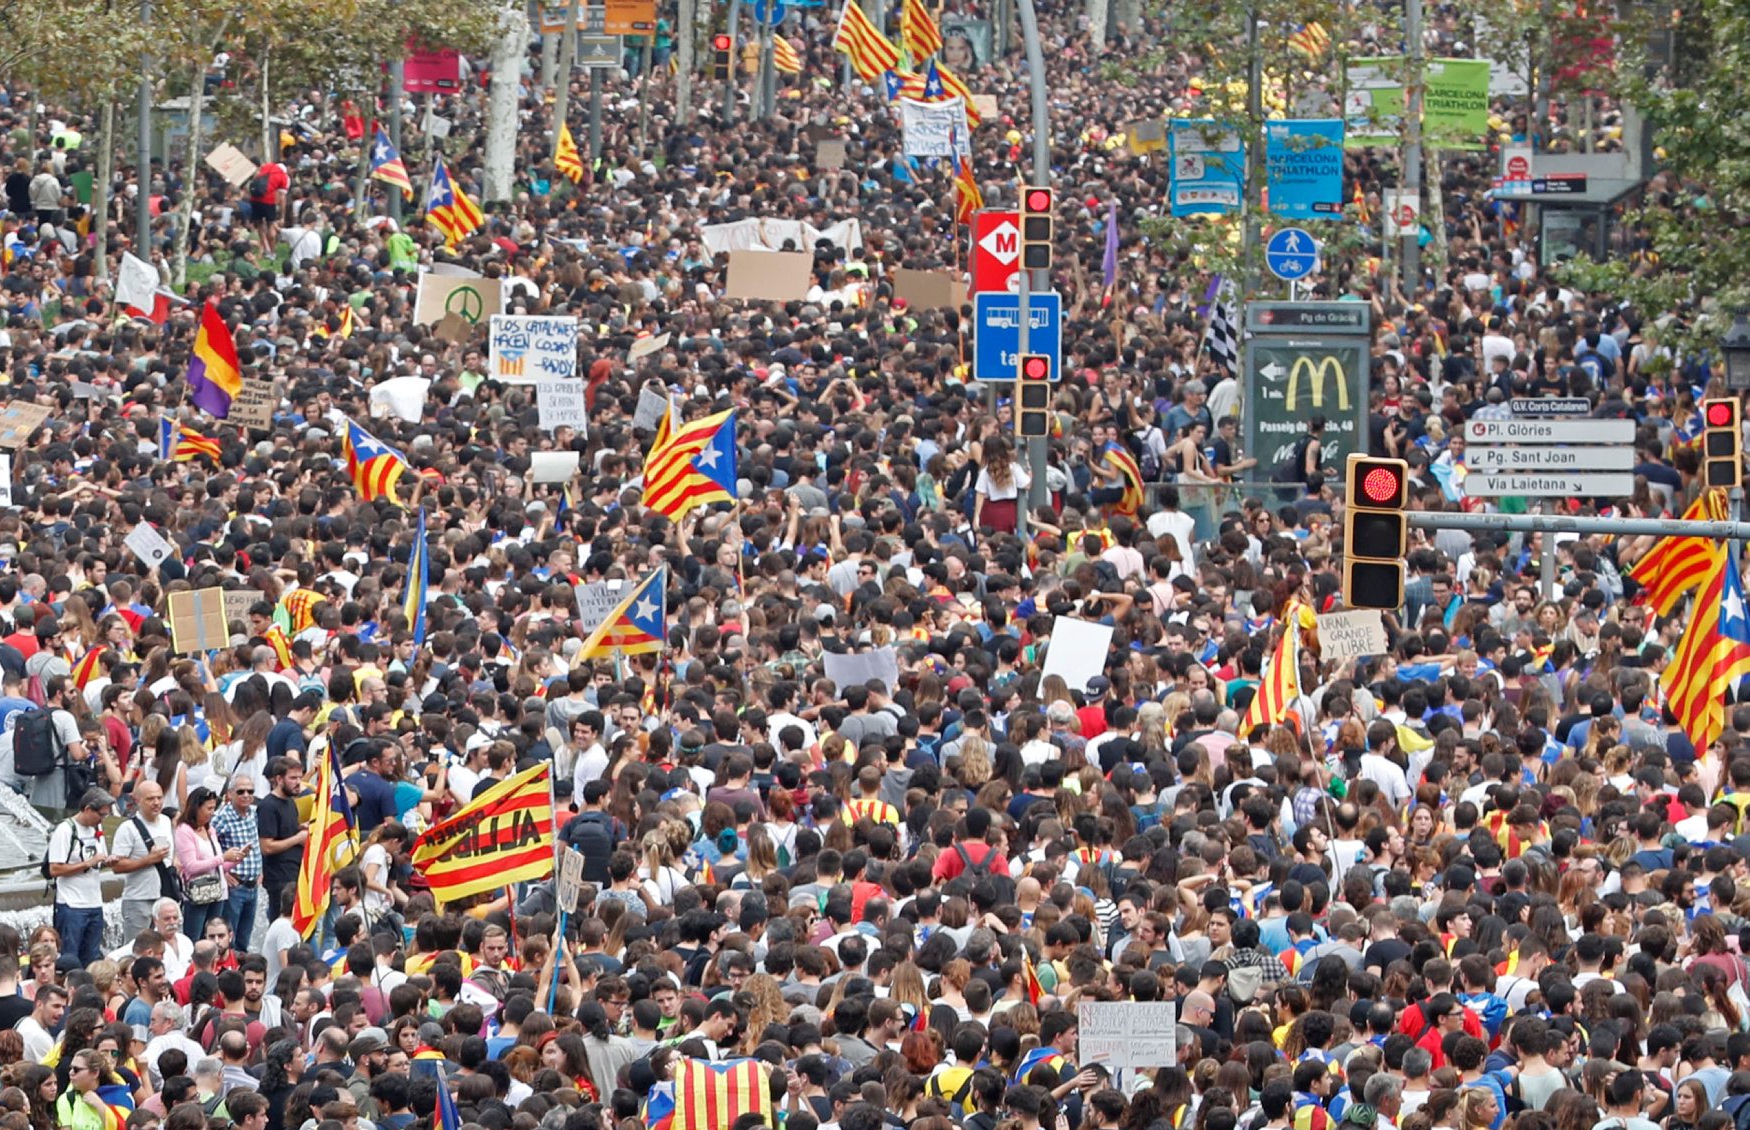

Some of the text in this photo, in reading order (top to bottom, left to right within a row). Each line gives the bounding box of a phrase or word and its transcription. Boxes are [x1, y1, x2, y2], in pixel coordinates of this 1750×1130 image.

[1427, 89, 1485, 99] BARCELONA
[1427, 99, 1486, 110] TRIATHLON
[1271, 153, 1338, 164] BARCELONA
[1272, 165, 1339, 176] TRIATHLON
[996, 233, 1016, 253] M
[1301, 313, 1313, 323] Pg
[1315, 314, 1326, 322] de
[493, 333, 530, 348] HACEN
[1262, 386, 1267, 399] 1
[1528, 401, 1549, 412] Corts
[1550, 401, 1588, 412] Catalanes
[1260, 421, 1296, 434] Passeig
[1296, 420, 1308, 432] de
[1488, 423, 1552, 436] Pl. Glòries
[1487, 451, 1576, 465] Pg. Sant Joan
[1488, 478, 1566, 490] Via Laietana
[1330, 626, 1372, 641] GRANDE
[1327, 638, 1375, 657] Y LIBRE
